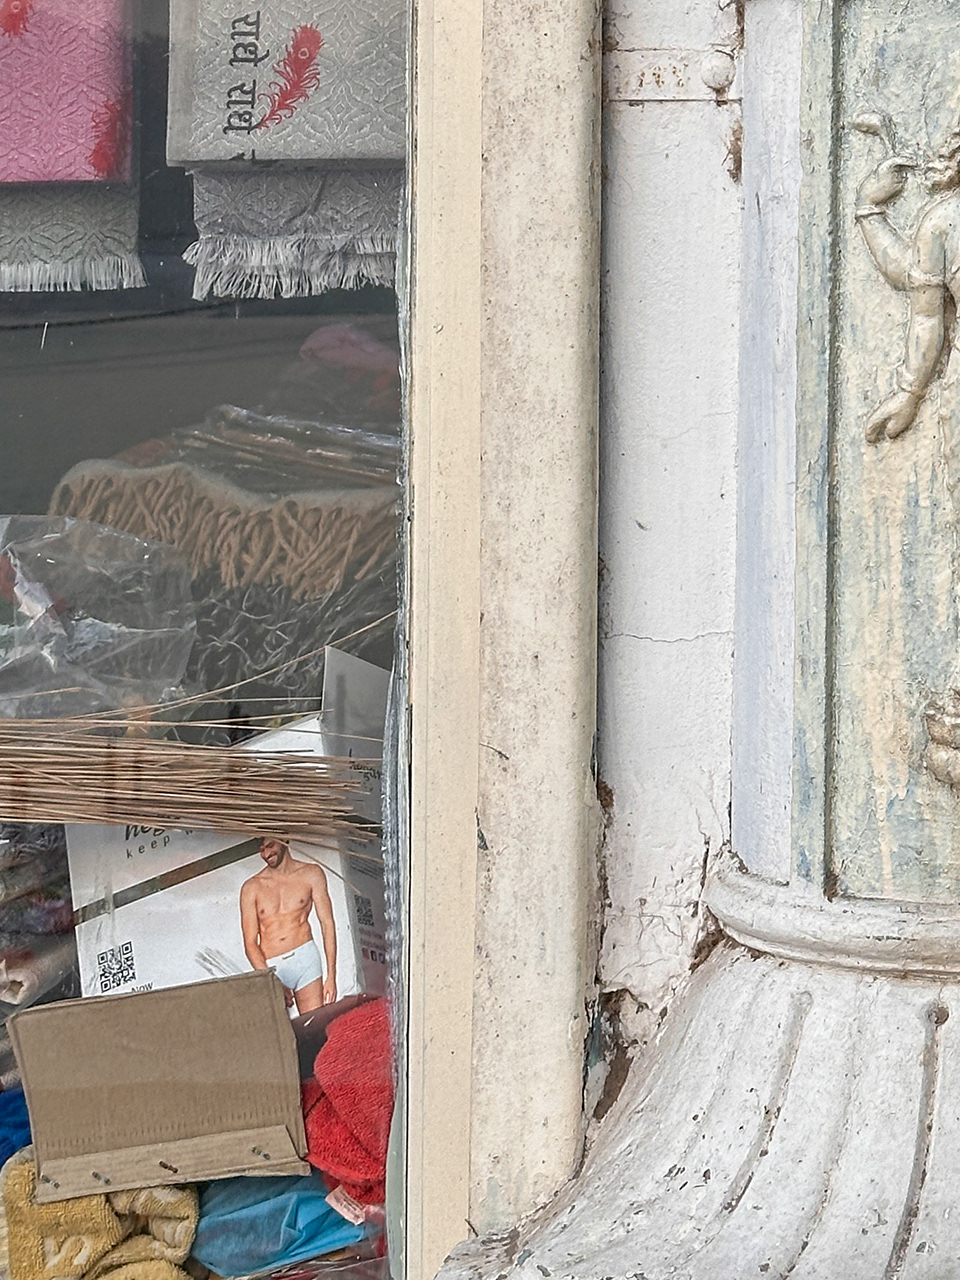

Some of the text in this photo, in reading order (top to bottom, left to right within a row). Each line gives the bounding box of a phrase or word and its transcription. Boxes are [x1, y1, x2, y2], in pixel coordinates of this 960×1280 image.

[228, 10, 270, 68] राधे
[222, 79, 264, 135] राधे
[126, 834, 170, 859] keep
